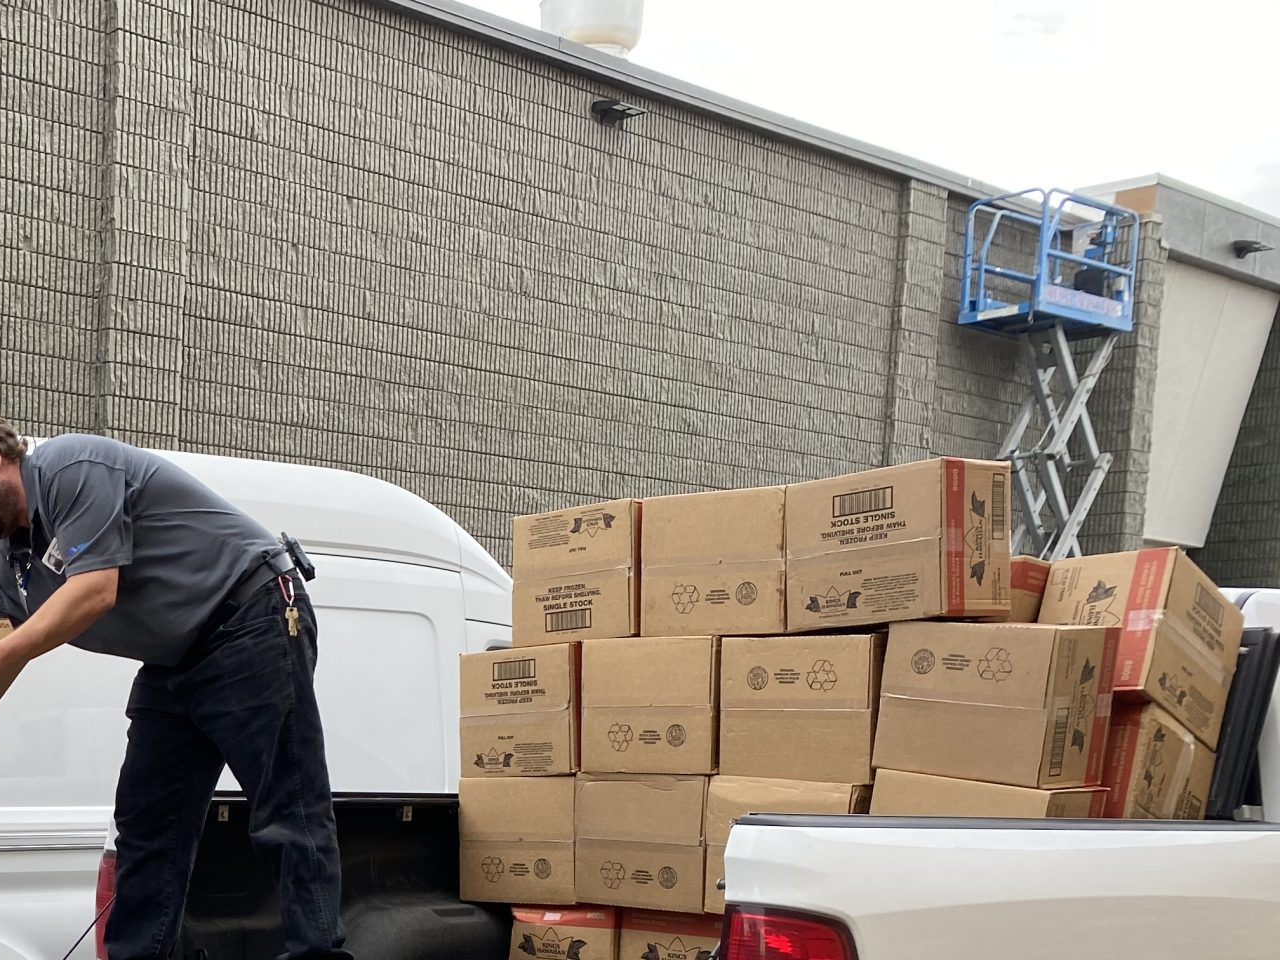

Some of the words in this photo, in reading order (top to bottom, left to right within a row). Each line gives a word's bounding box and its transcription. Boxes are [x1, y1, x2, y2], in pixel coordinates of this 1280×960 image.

[863, 512, 895, 523] SINGLE
[831, 519, 860, 528] STOCK
[888, 521, 906, 529] THAW
[857, 524, 884, 534] BEFORE
[869, 533, 887, 541] KEEP
[552, 593, 572, 601] BEFORE
[544, 602, 567, 611] SINGLE
[570, 599, 593, 608] STOCK
